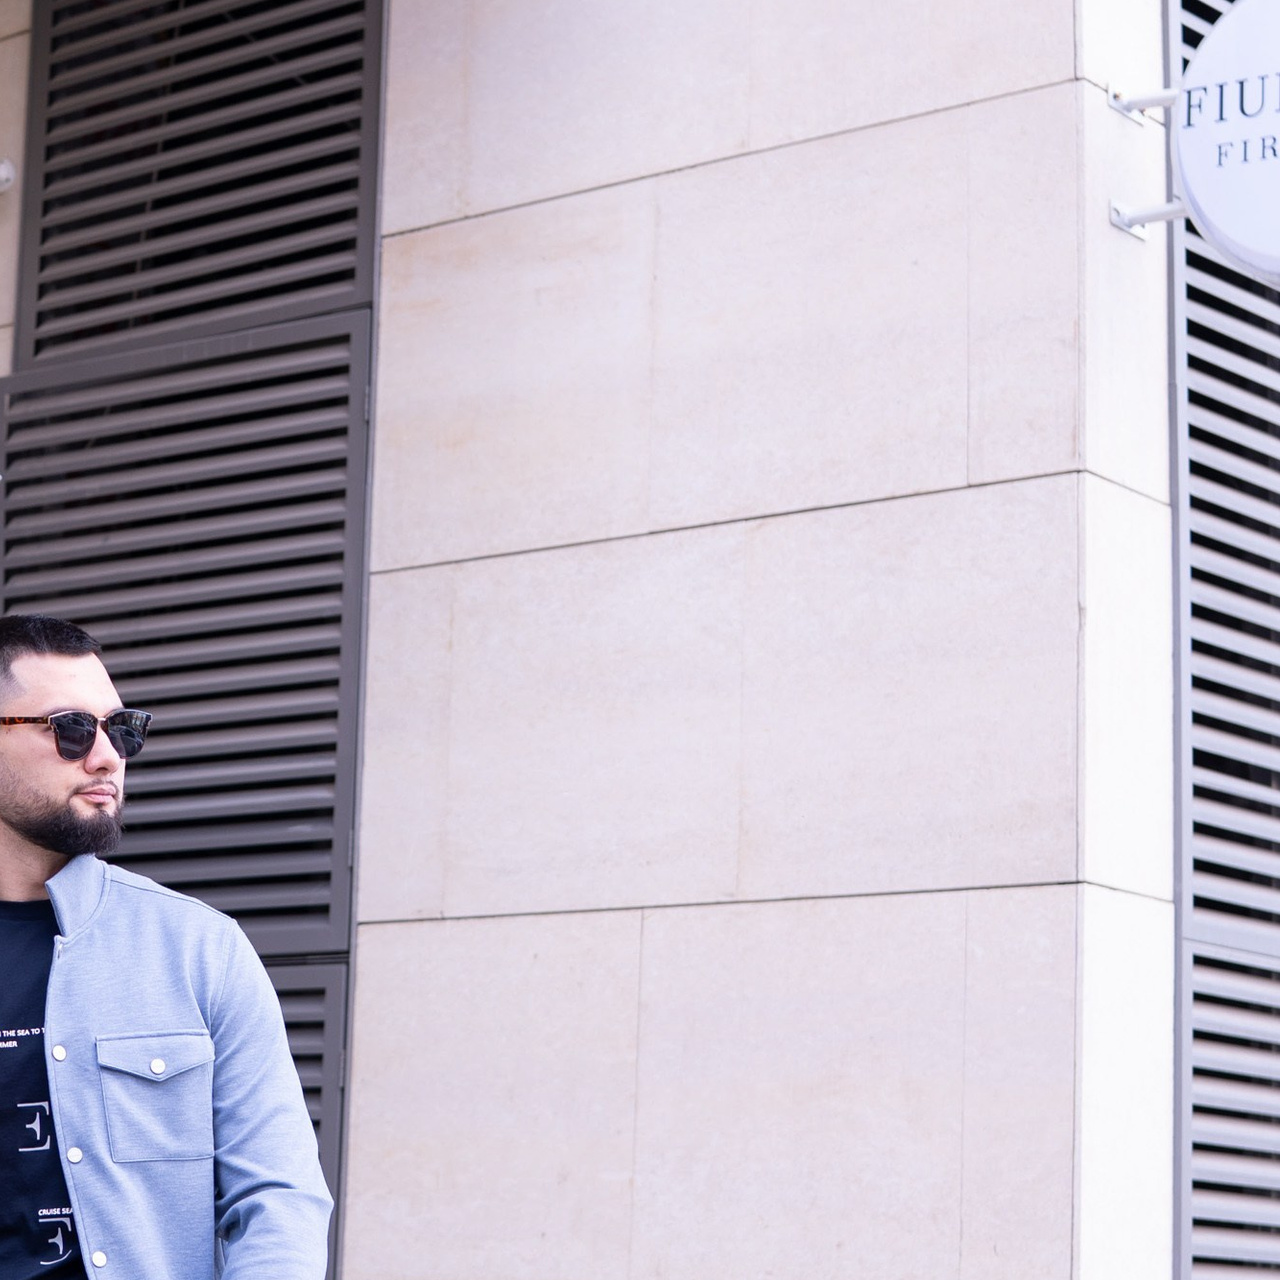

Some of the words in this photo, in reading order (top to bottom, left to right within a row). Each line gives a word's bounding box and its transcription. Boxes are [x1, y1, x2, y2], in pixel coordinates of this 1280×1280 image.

[1181, 72, 1280, 129] FIU
[2, 1029, 16, 1037] THE
[30, 1027, 41, 1035] TO
[38, 1207, 61, 1216] CRUISE
